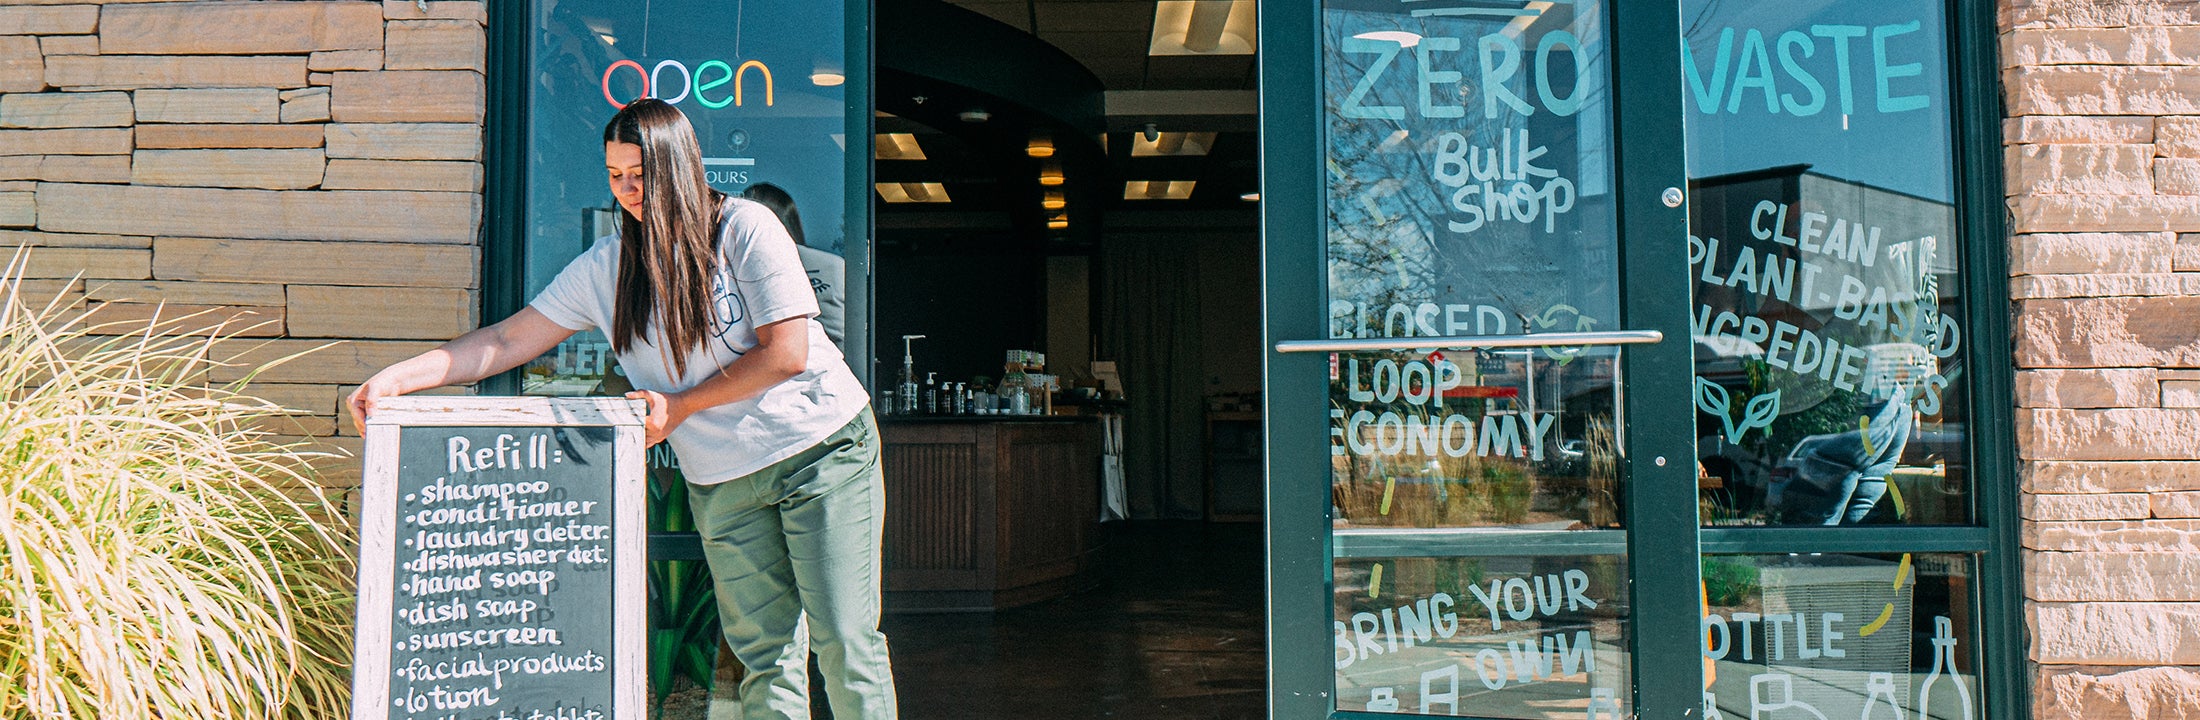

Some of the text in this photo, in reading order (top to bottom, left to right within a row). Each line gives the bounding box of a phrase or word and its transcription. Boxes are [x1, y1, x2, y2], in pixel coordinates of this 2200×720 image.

[602, 59, 773, 110] open
[1341, 29, 1590, 120] ZERO
[705, 171, 748, 184] OURS
[1434, 127, 1559, 187] Bulk
[1449, 176, 1575, 234] Shop
[1751, 200, 1881, 267] CLEAN
[1329, 300, 1507, 353] CLOSED
[1349, 357, 1462, 407] LOOP
[1692, 304, 1948, 416] NGREDIENTS
[449, 434, 562, 473] Refill:
[416, 499, 597, 526] conditioner
[421, 477, 549, 507] shampoo
[417, 520, 609, 552] laundry deter.
[412, 544, 609, 573] dishwasher det.
[411, 570, 555, 597] hand soap
[408, 597, 537, 625] dish soap
[1335, 569, 1598, 670] BRING YOUR
[409, 627, 562, 650] sunscreen
[1703, 612, 1846, 661] OTTLE
[405, 650, 605, 690] facial products
[1475, 630, 1596, 691] OWN
[407, 685, 499, 713] lotion
